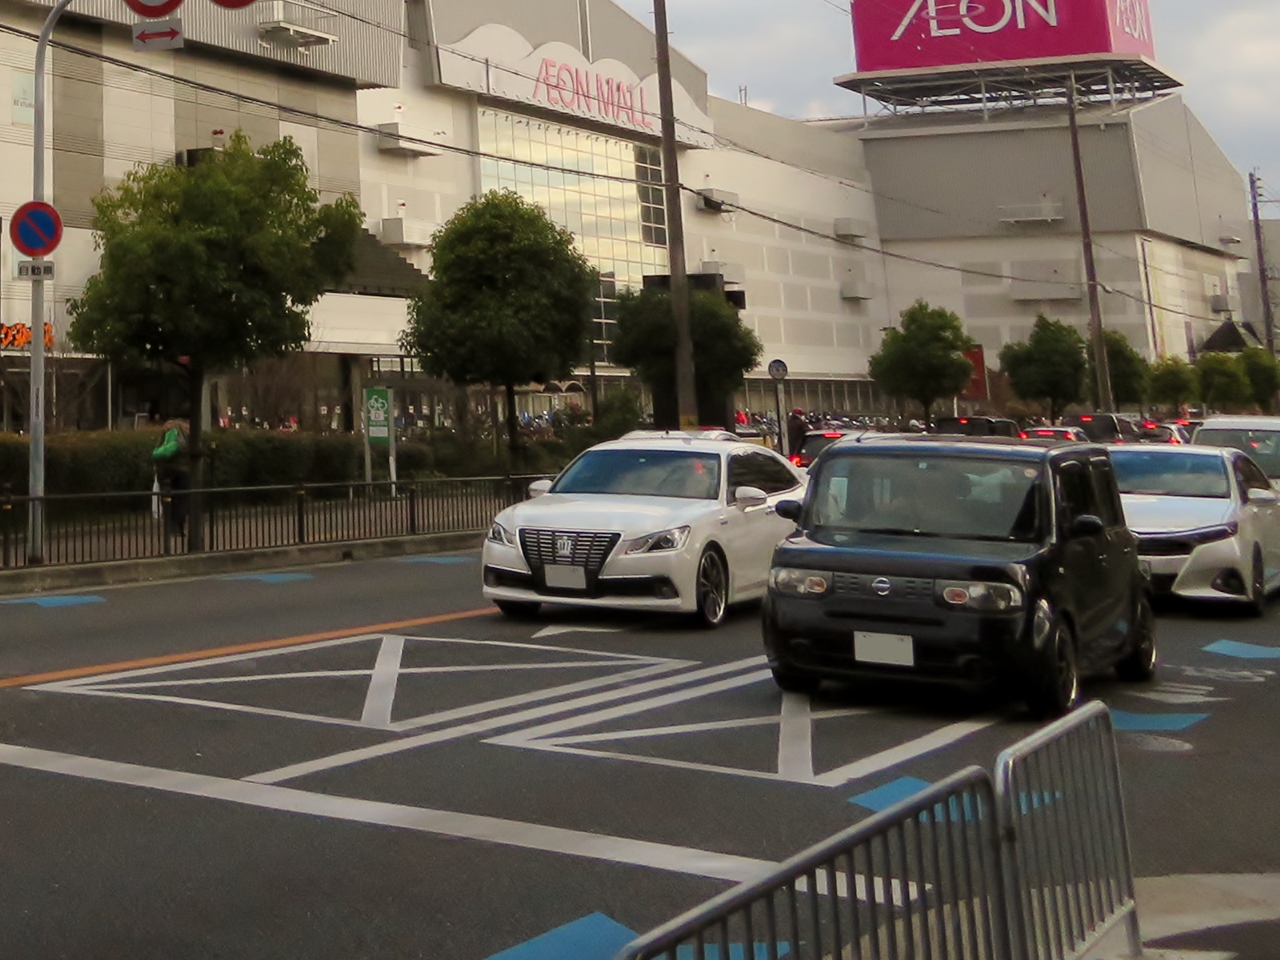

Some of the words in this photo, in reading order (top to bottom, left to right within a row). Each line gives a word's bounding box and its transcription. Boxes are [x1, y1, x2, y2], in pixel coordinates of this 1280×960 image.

[595, 73, 654, 128] MALL
[19, 265, 53, 276] 自動車
